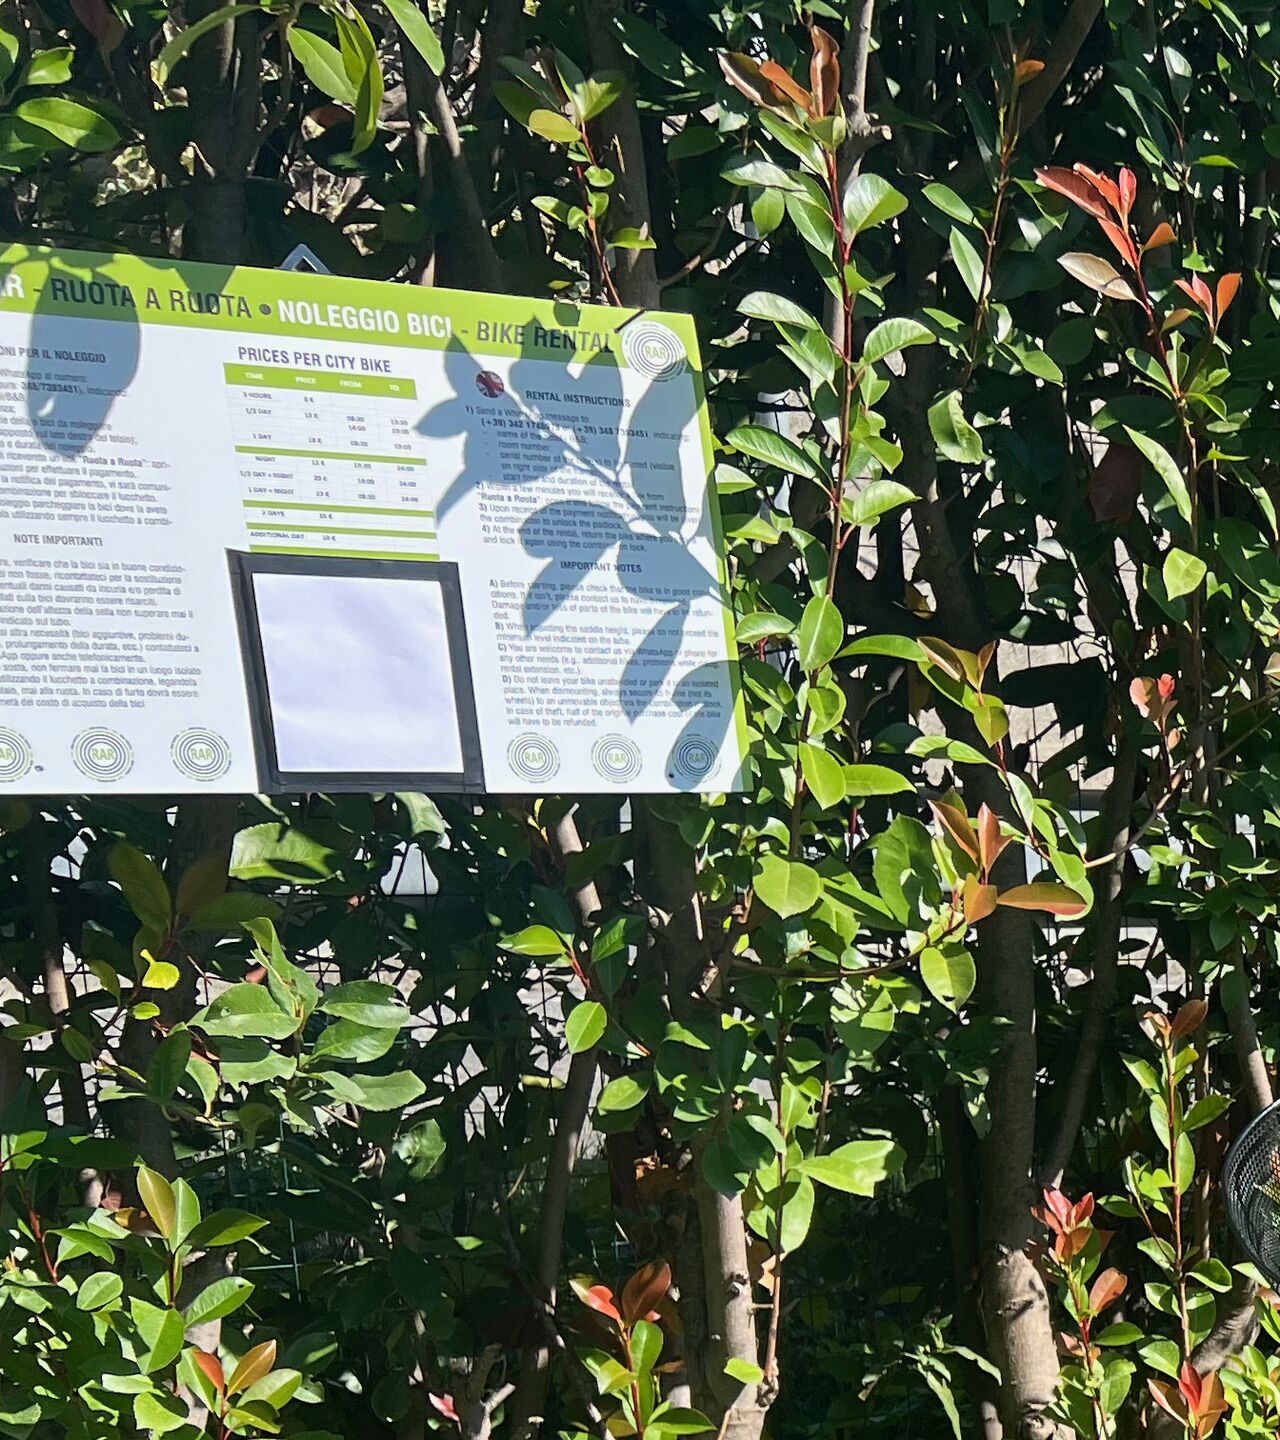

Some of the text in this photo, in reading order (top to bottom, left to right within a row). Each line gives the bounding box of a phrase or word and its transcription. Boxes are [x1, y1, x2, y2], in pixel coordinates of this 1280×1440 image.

[50, 277, 136, 308] RUOTA
[143, 286, 160, 310] A
[169, 288, 251, 319] RUOTA
[277, 300, 401, 333] NOLEGGIO
[406, 312, 453, 338] BICI
[474, 320, 524, 345] BIKE
[531, 325, 613, 353] RENTAL
[17, 346, 39, 358] PER
[41, 348, 51, 359] IL
[54, 349, 106, 363] NOLEGGIO
[644, 345, 666, 359] RAR
[237, 346, 392, 373] PRICES PER CITY BIKE
[525, 390, 631, 407] RENTAL INSTRUCTIONS
[12, 533, 103, 547] NOTE IMPORTANTI
[560, 560, 642, 572] IMPORTANT NOTES
[90, 748, 116, 760] RAR
[189, 747, 213, 760] RAR
[523, 751, 545, 763] RAR
[607, 751, 627, 764] RAR
